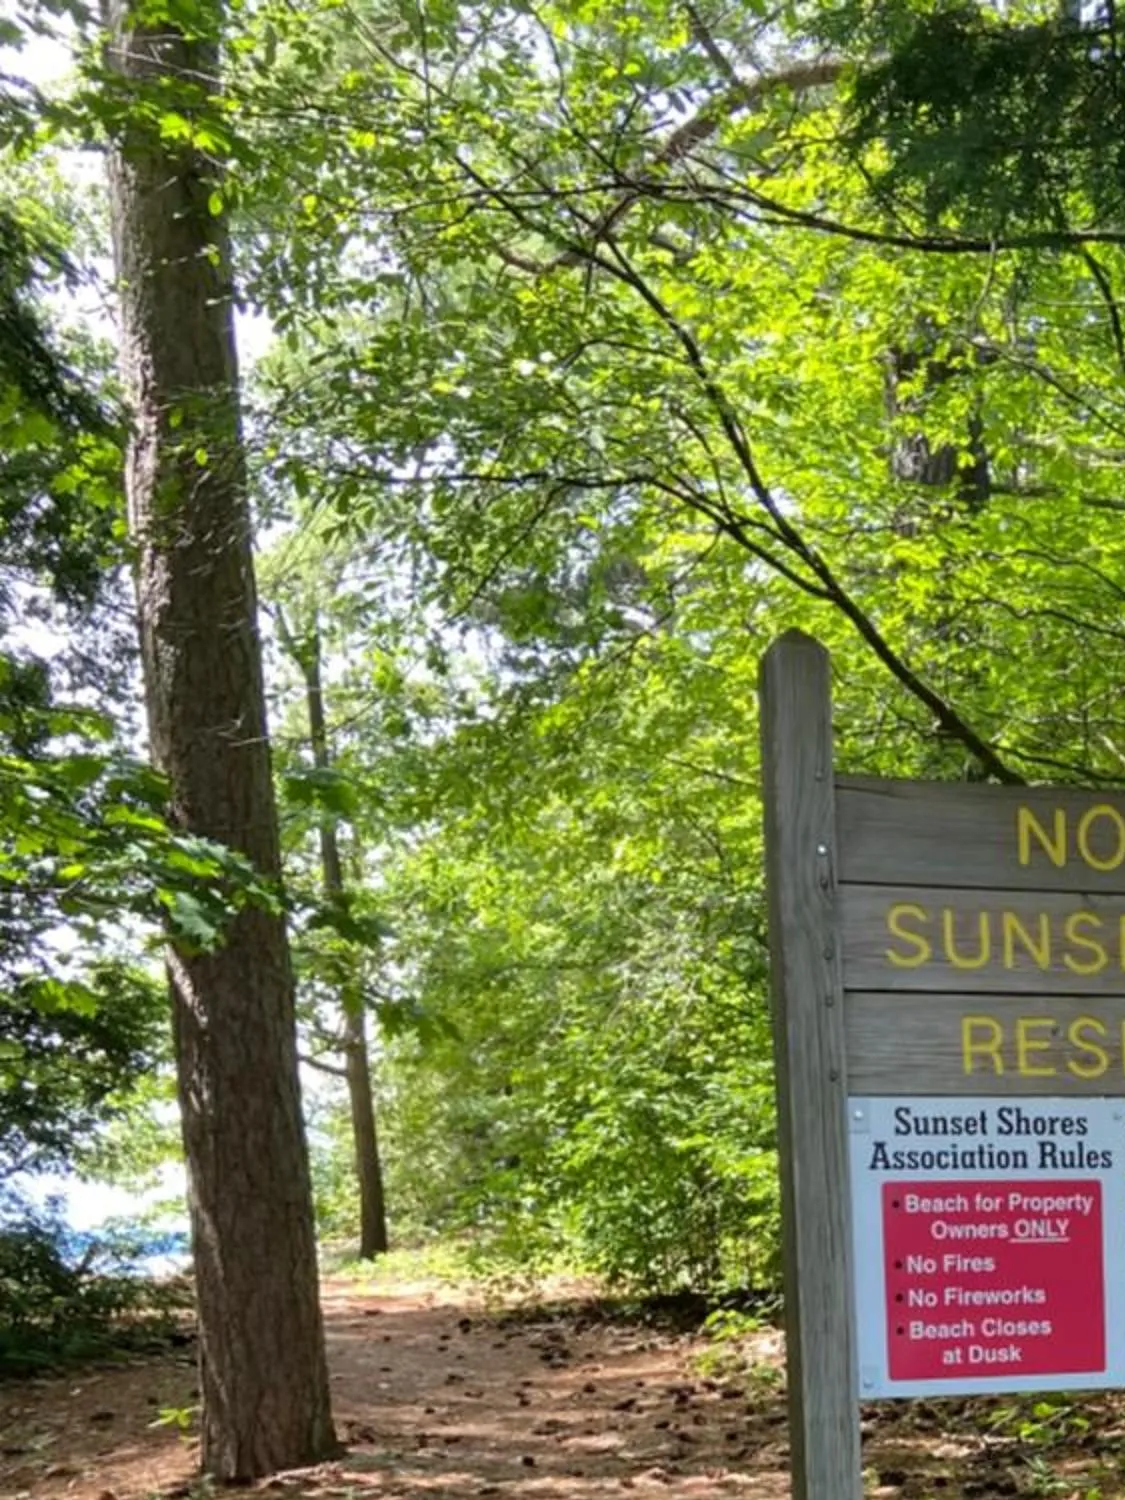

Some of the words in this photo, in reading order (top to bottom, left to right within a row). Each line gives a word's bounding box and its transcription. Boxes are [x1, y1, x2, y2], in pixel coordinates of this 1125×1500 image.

[894, 1107, 987, 1136] Sunset
[996, 1106, 1088, 1136] Shores
[869, 1141, 1028, 1171] Association
[1037, 1141, 1113, 1170] Rules
[904, 1193, 969, 1213] Beach
[974, 1193, 1002, 1212] for
[1008, 1192, 1094, 1215] Property
[931, 1220, 1009, 1240] Owners
[1012, 1219, 1070, 1241] ONLY
[906, 1255, 937, 1274] No
[943, 1254, 996, 1273] Fires
[908, 1288, 938, 1307] No
[943, 1286, 1047, 1306] Fireworks
[909, 1319, 974, 1340] Beach
[981, 1318, 1052, 1338] Closes
[943, 1347, 962, 1364] at
[968, 1344, 1022, 1364] Dusk
